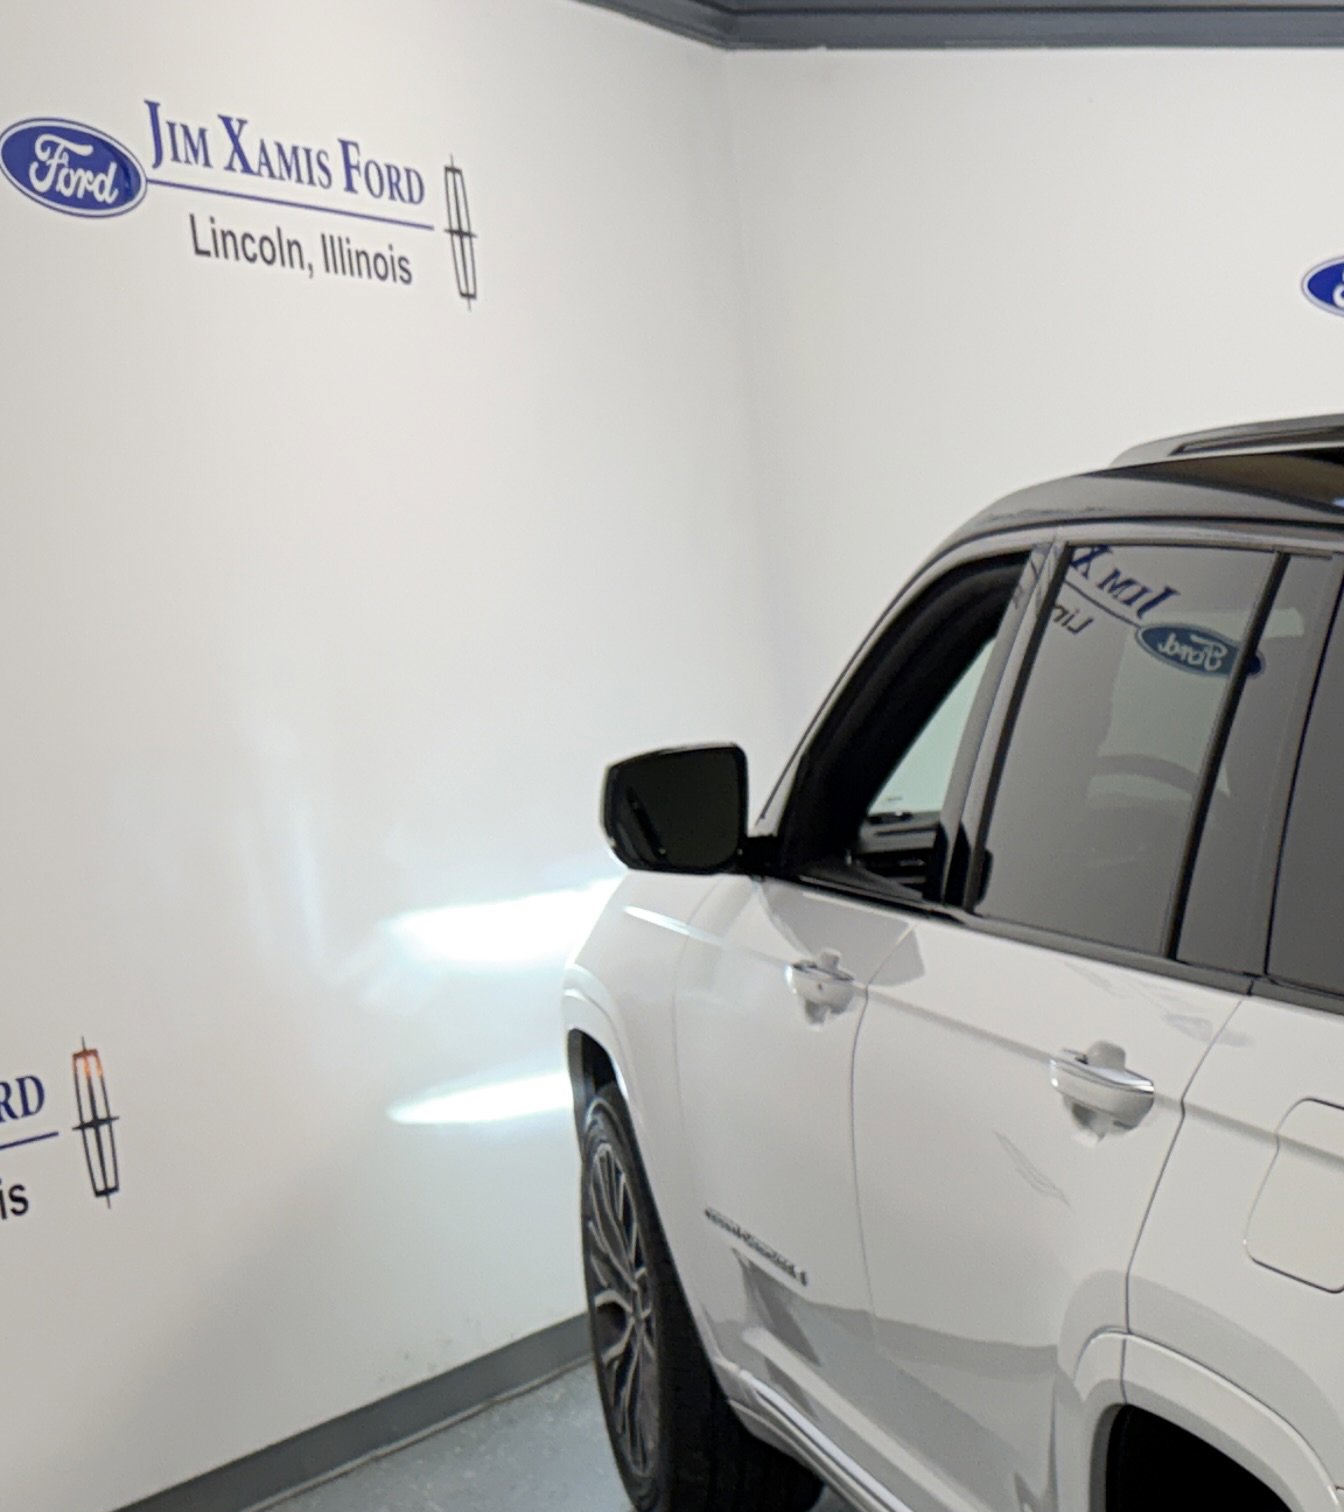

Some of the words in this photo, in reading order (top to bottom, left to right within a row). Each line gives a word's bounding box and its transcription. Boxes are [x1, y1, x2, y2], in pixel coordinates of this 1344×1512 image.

[28, 133, 120, 204] Ford
[144, 99, 213, 169] JIM
[217, 114, 333, 189] XAMIS
[337, 138, 426, 206] FORD
[189, 213, 315, 279] Lincoln,
[320, 232, 414, 285] Illinois
